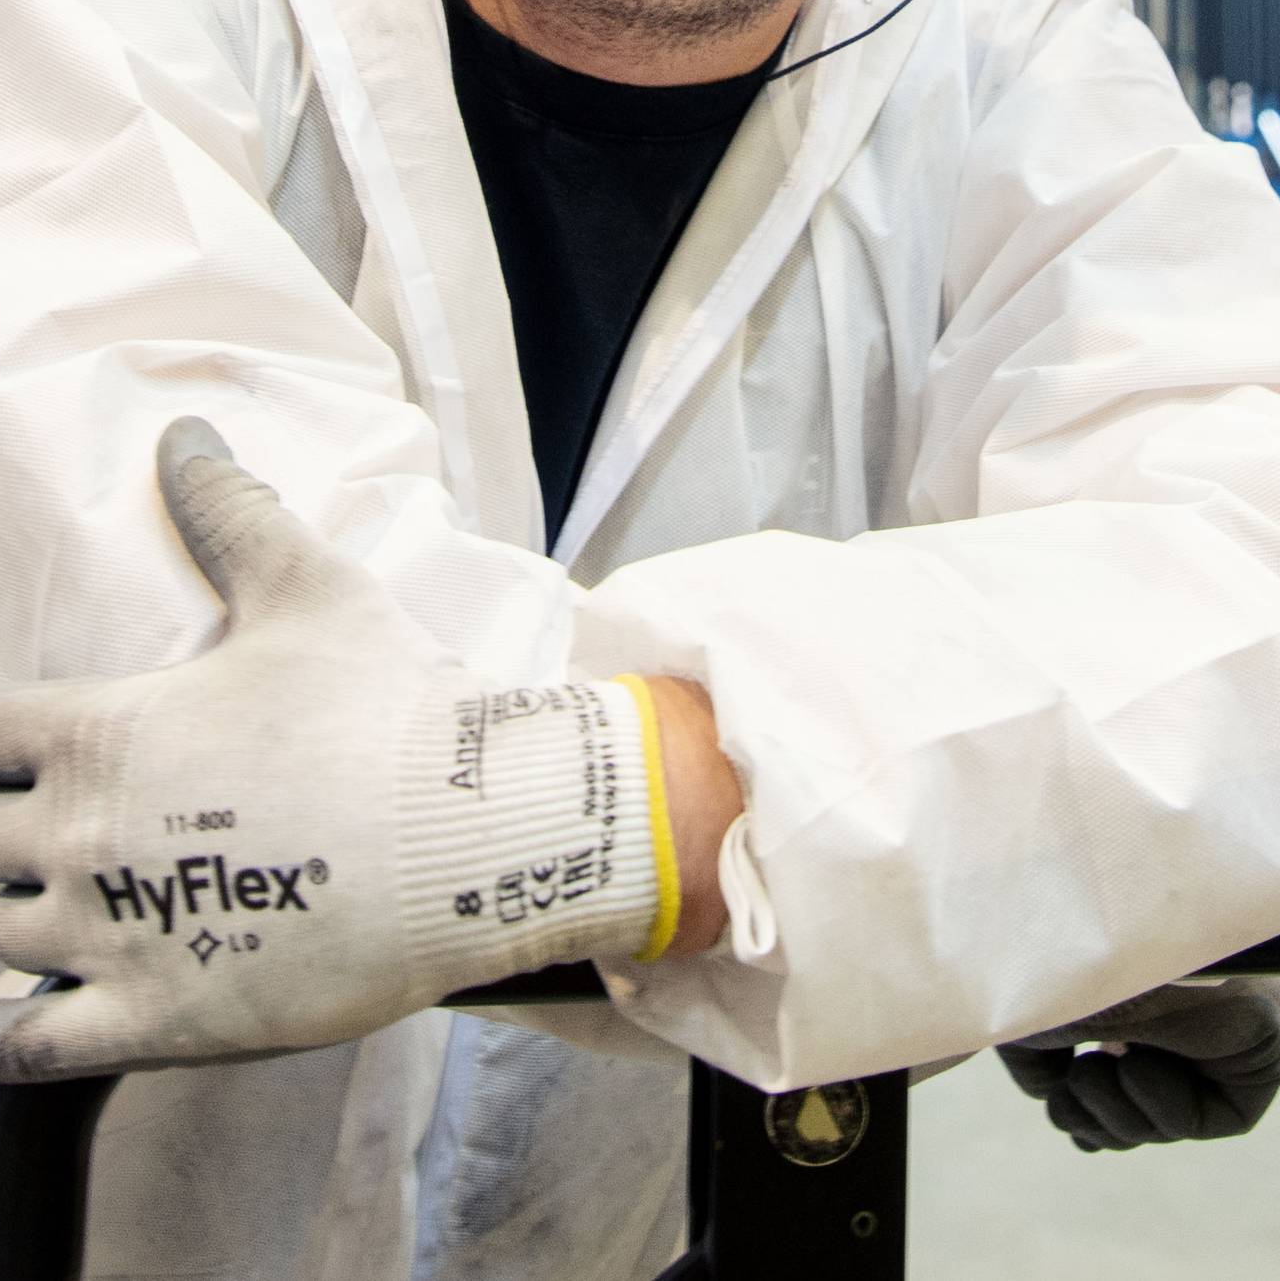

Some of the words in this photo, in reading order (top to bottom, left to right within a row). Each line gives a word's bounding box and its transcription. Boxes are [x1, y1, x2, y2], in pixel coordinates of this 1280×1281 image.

[448, 699, 480, 790] Ansell
[582, 761, 598, 815] Made
[165, 810, 236, 835] 11-800
[454, 889, 483, 917] 8
